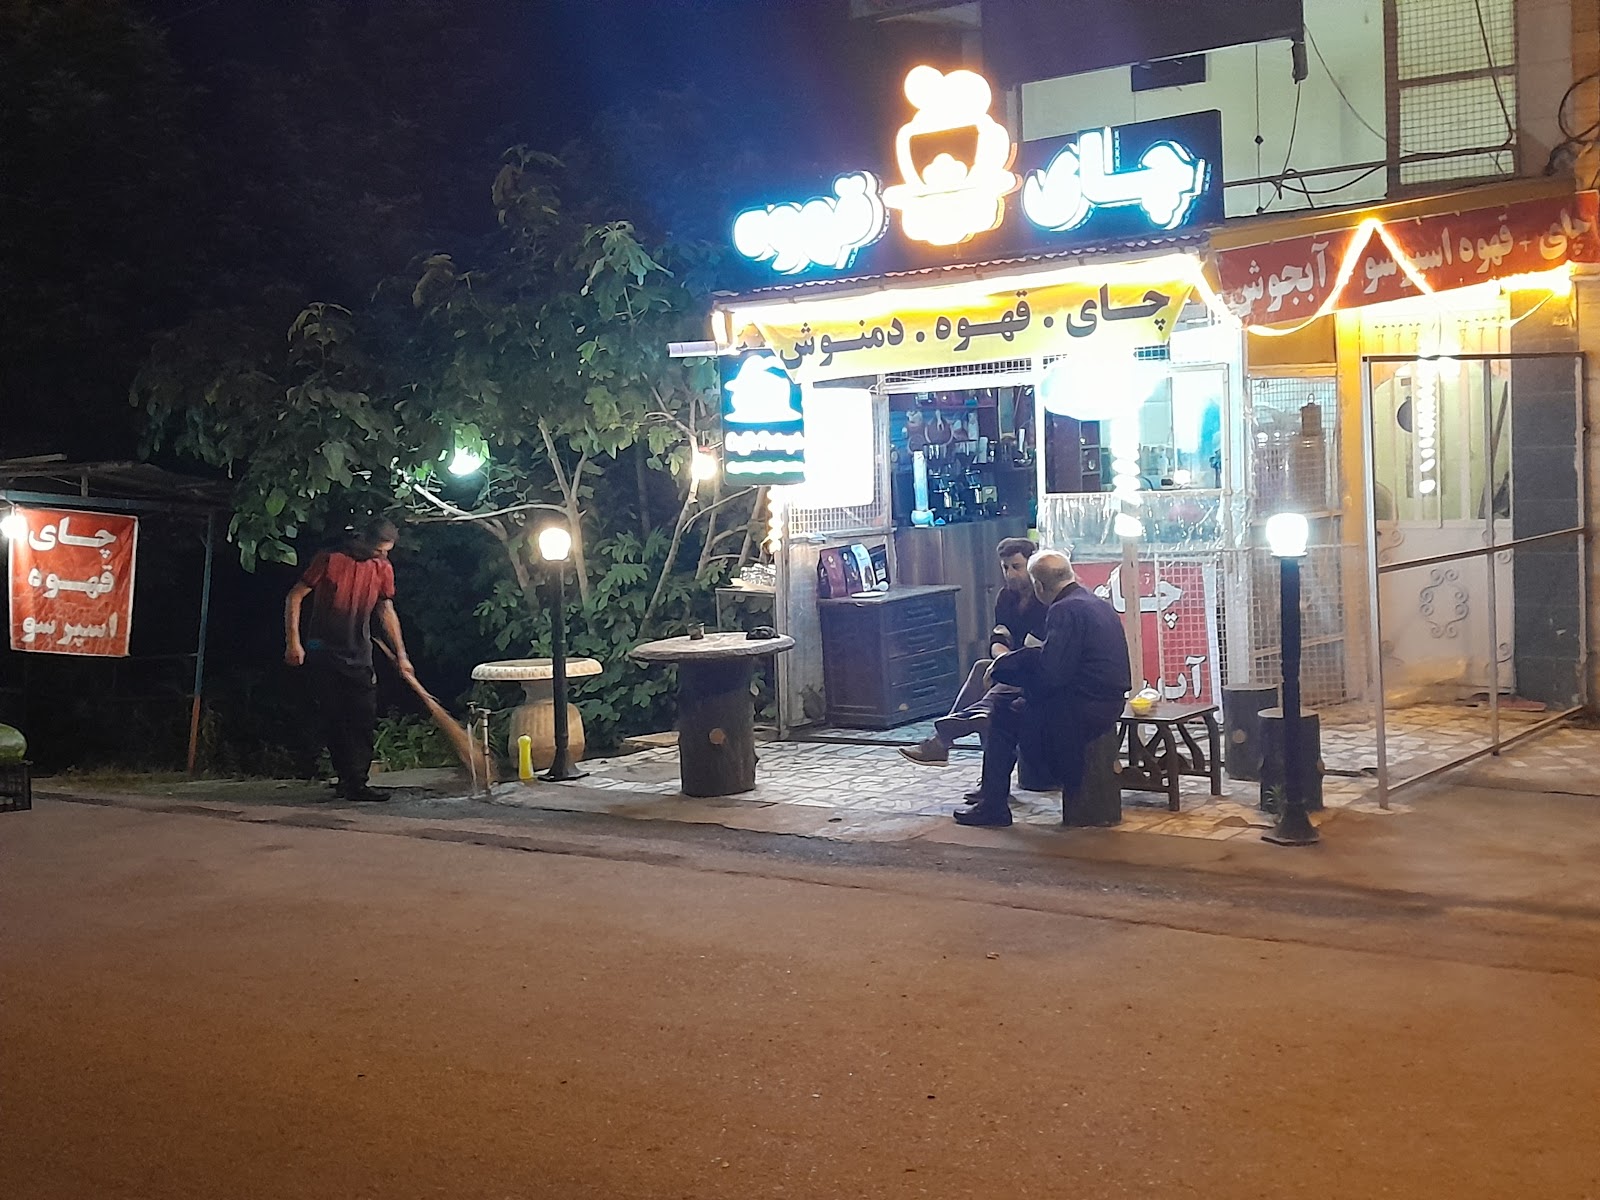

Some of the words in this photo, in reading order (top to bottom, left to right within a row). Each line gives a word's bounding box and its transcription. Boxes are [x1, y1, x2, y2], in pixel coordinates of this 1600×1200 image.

[1459, 213, 1514, 274] قهوه
[934, 290, 1032, 351] قهوه
[1066, 284, 1171, 338] چای
[778, 317, 905, 369] دمنوش
[28, 516, 118, 559] چای
[27, 563, 116, 599] قهوه
